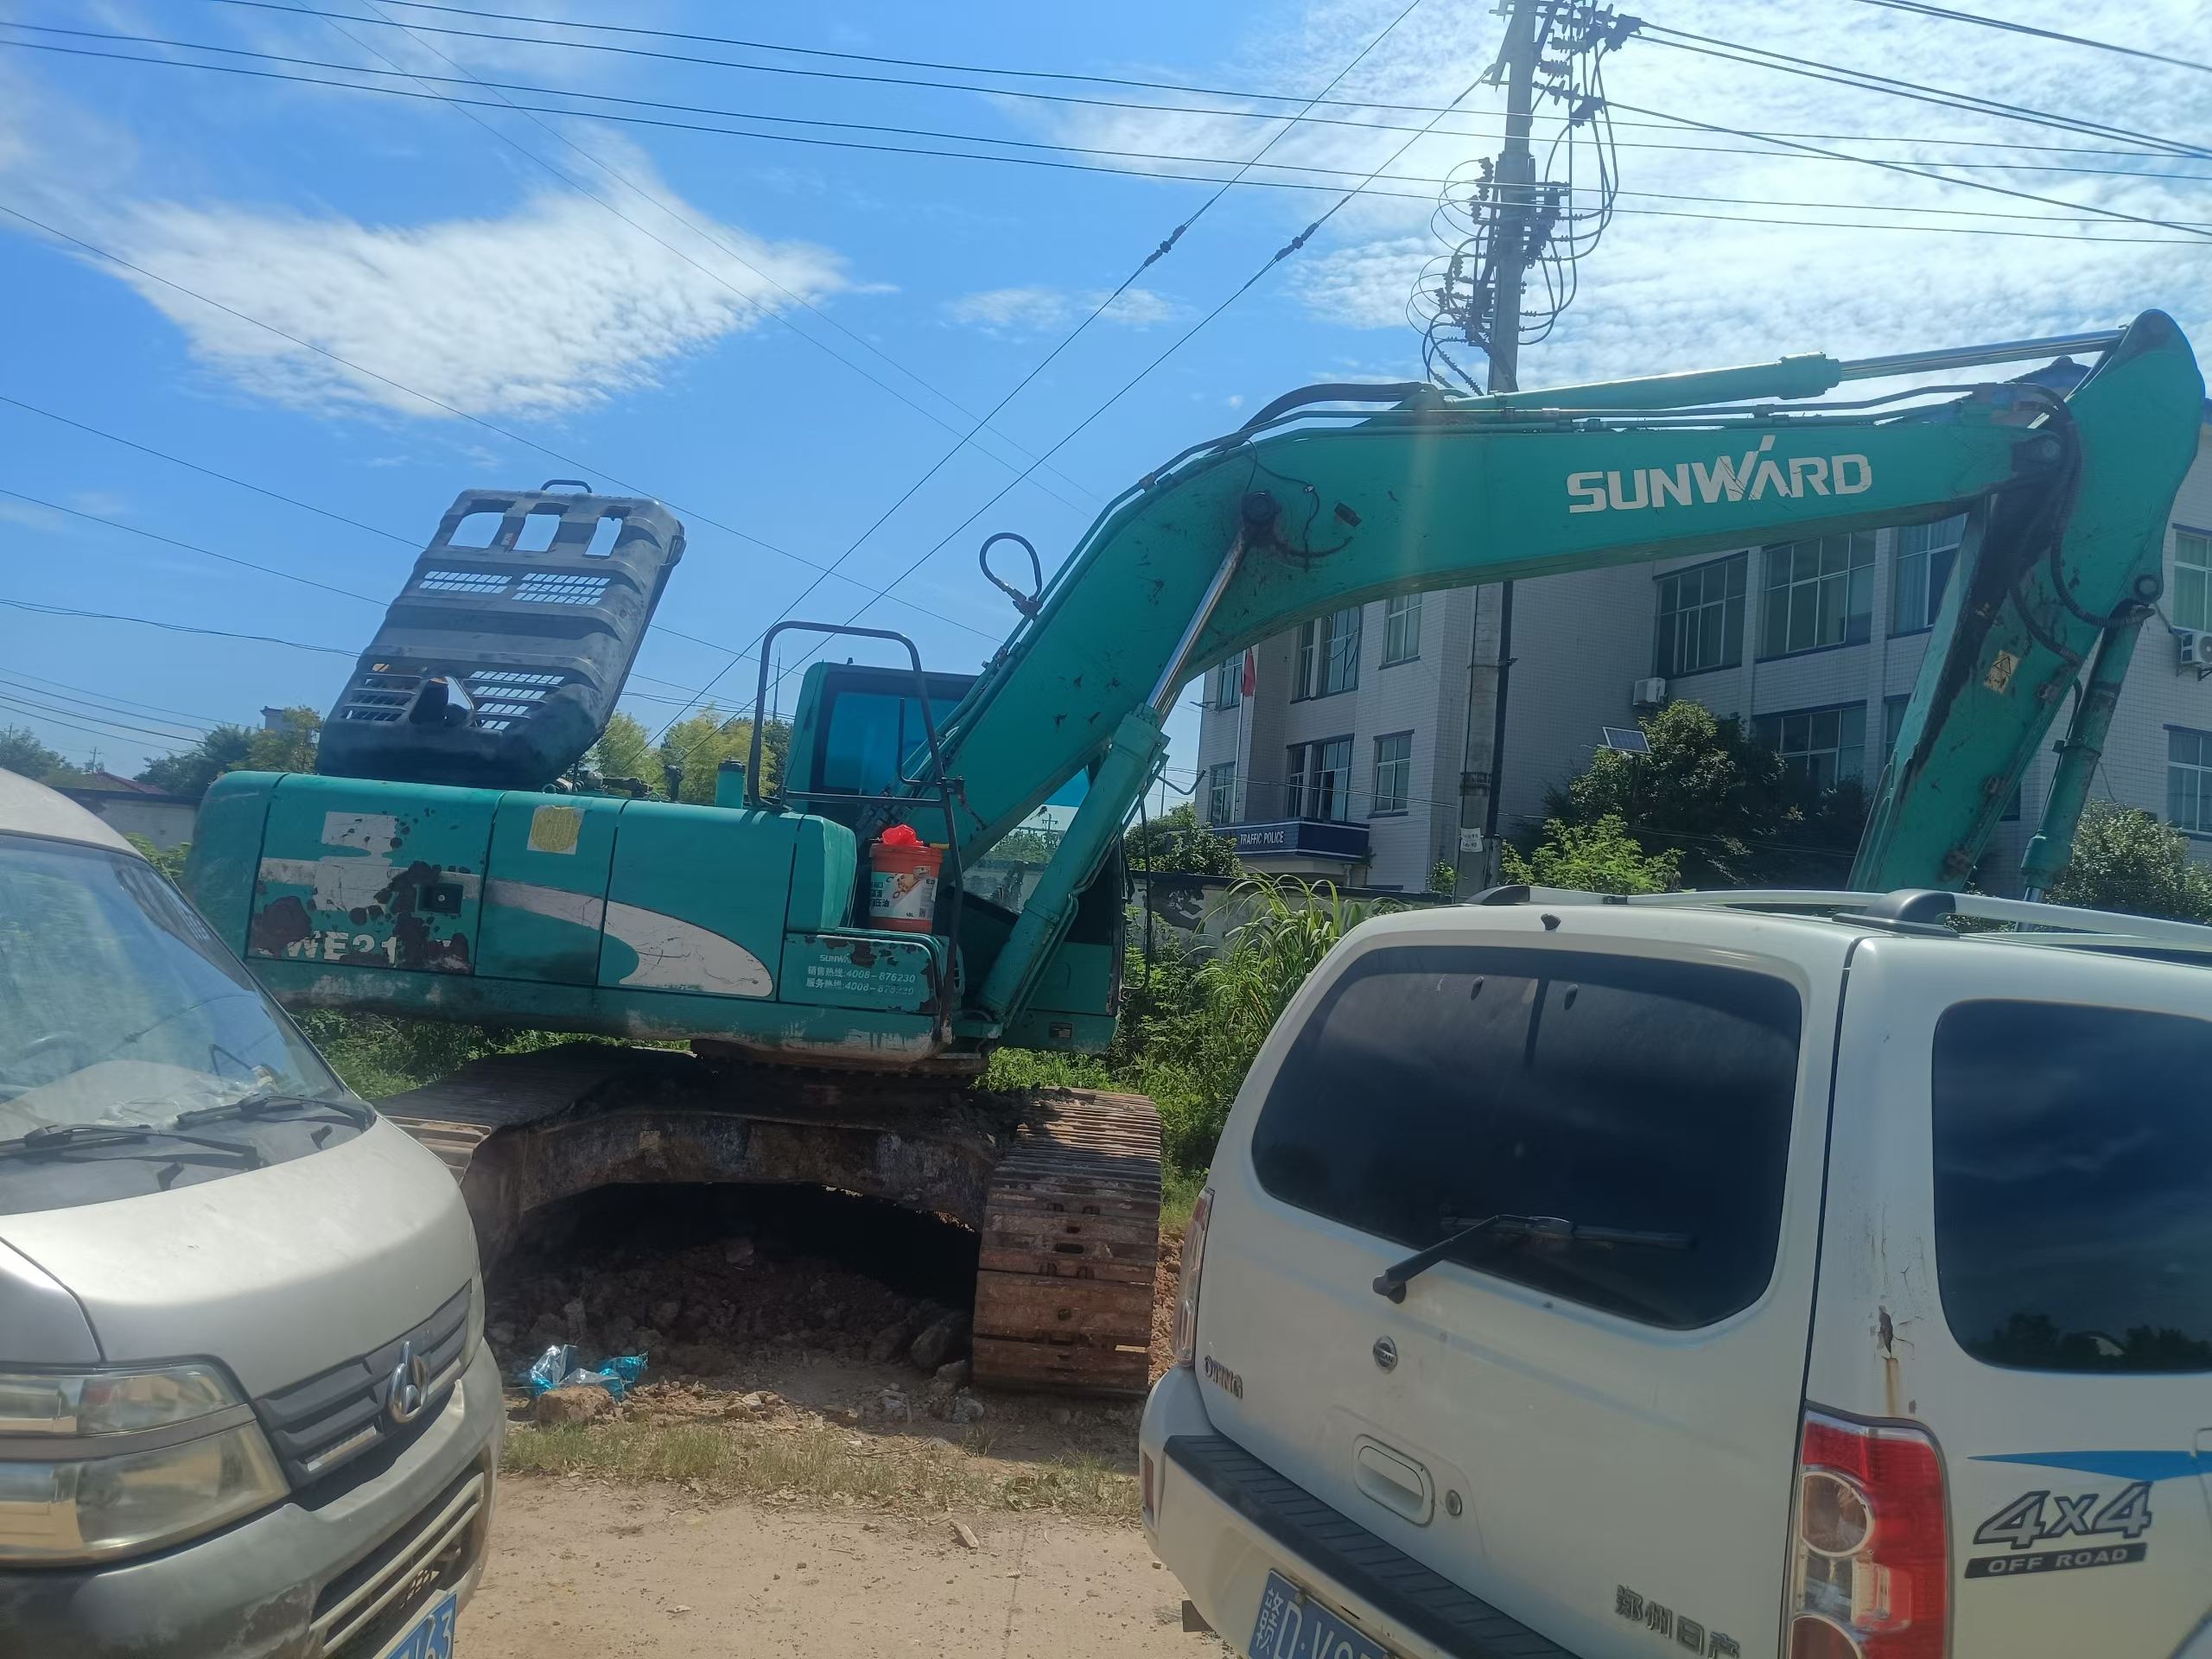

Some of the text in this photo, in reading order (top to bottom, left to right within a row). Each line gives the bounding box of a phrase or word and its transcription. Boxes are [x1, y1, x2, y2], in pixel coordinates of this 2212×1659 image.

[1567, 435, 1872, 514] SUNWARD
[1240, 830, 1285, 845] TRAFFIC POLICE
[1987, 1548, 2128, 1575] OFF ROAD
[1614, 1585, 1741, 1659] 郑州日产
